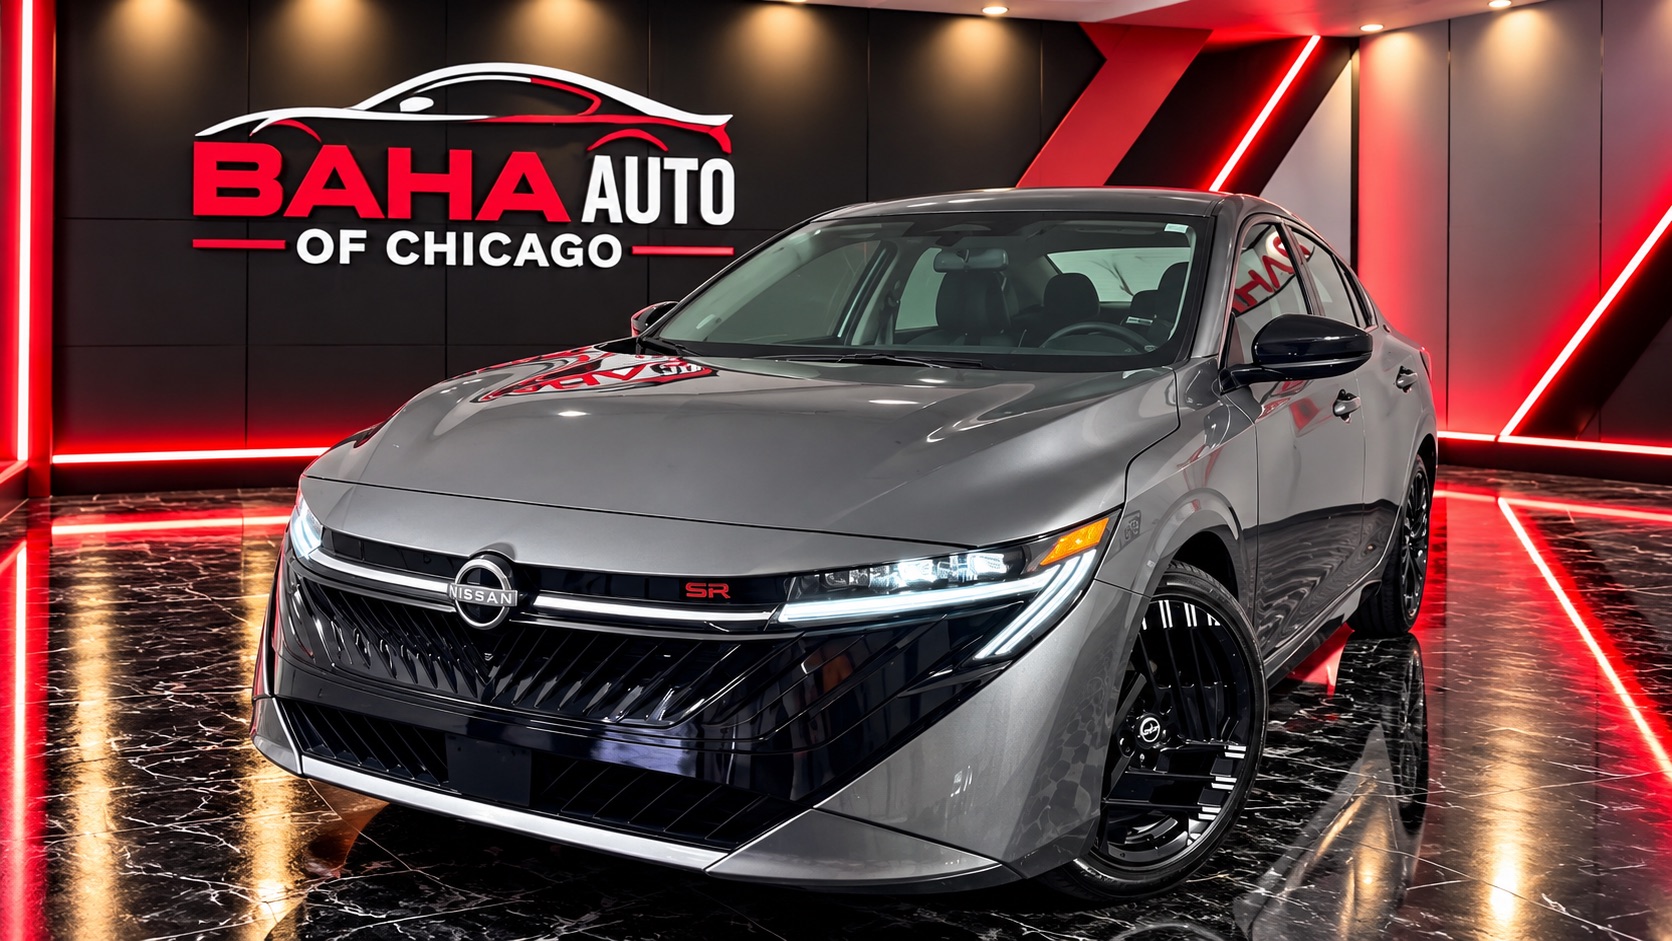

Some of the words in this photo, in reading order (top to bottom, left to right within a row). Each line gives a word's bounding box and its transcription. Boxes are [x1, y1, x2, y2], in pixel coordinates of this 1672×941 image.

[193, 141, 571, 223] BAHA
[581, 155, 735, 226] AUTO
[296, 228, 366, 265] OF
[386, 230, 622, 269] CHICAGO
[449, 584, 512, 605] NISSAN
[685, 582, 731, 599] SR
